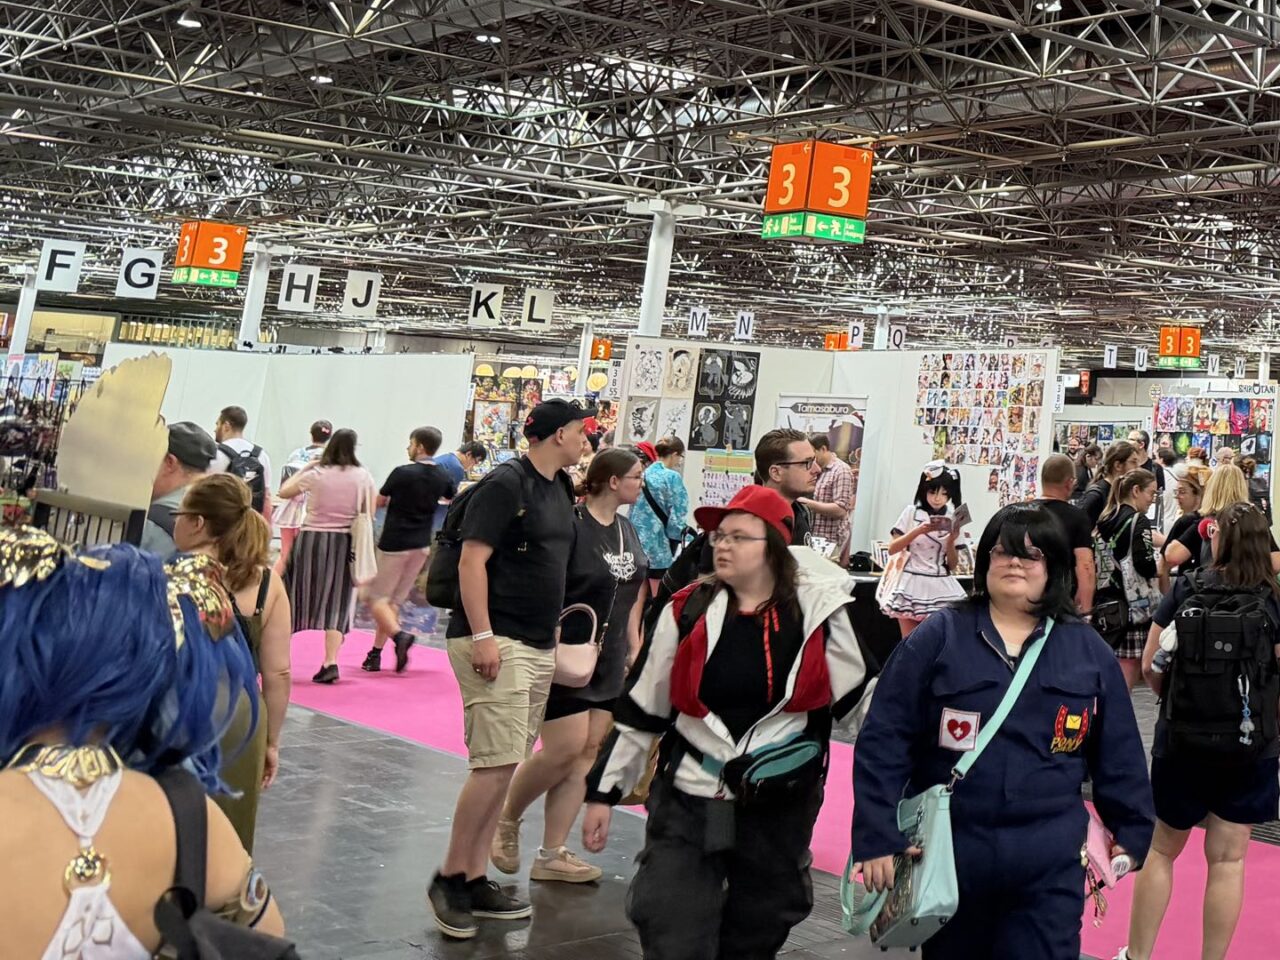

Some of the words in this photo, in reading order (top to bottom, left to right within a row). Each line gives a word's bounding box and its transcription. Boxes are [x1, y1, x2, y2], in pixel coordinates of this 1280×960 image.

[777, 163, 796, 206] 3
[827, 165, 851, 208] 3
[180, 235, 191, 263] 3
[208, 236, 229, 265] 3
[44, 248, 76, 281] F
[123, 257, 157, 289] G
[284, 272, 314, 304] H
[351, 279, 374, 308] J
[471, 290, 499, 320] K
[526, 295, 546, 324] L
[690, 311, 708, 332] M
[738, 315, 752, 335] N
[850, 325, 860, 344] P
[892, 329, 903, 349] Q
[1165, 335, 1174, 354] 3
[1186, 336, 1194, 355] 3
[597, 344, 605, 358] 3
[1107, 348, 1115, 365] T
[1137, 351, 1146, 368] U
[1210, 358, 1218, 373] V
